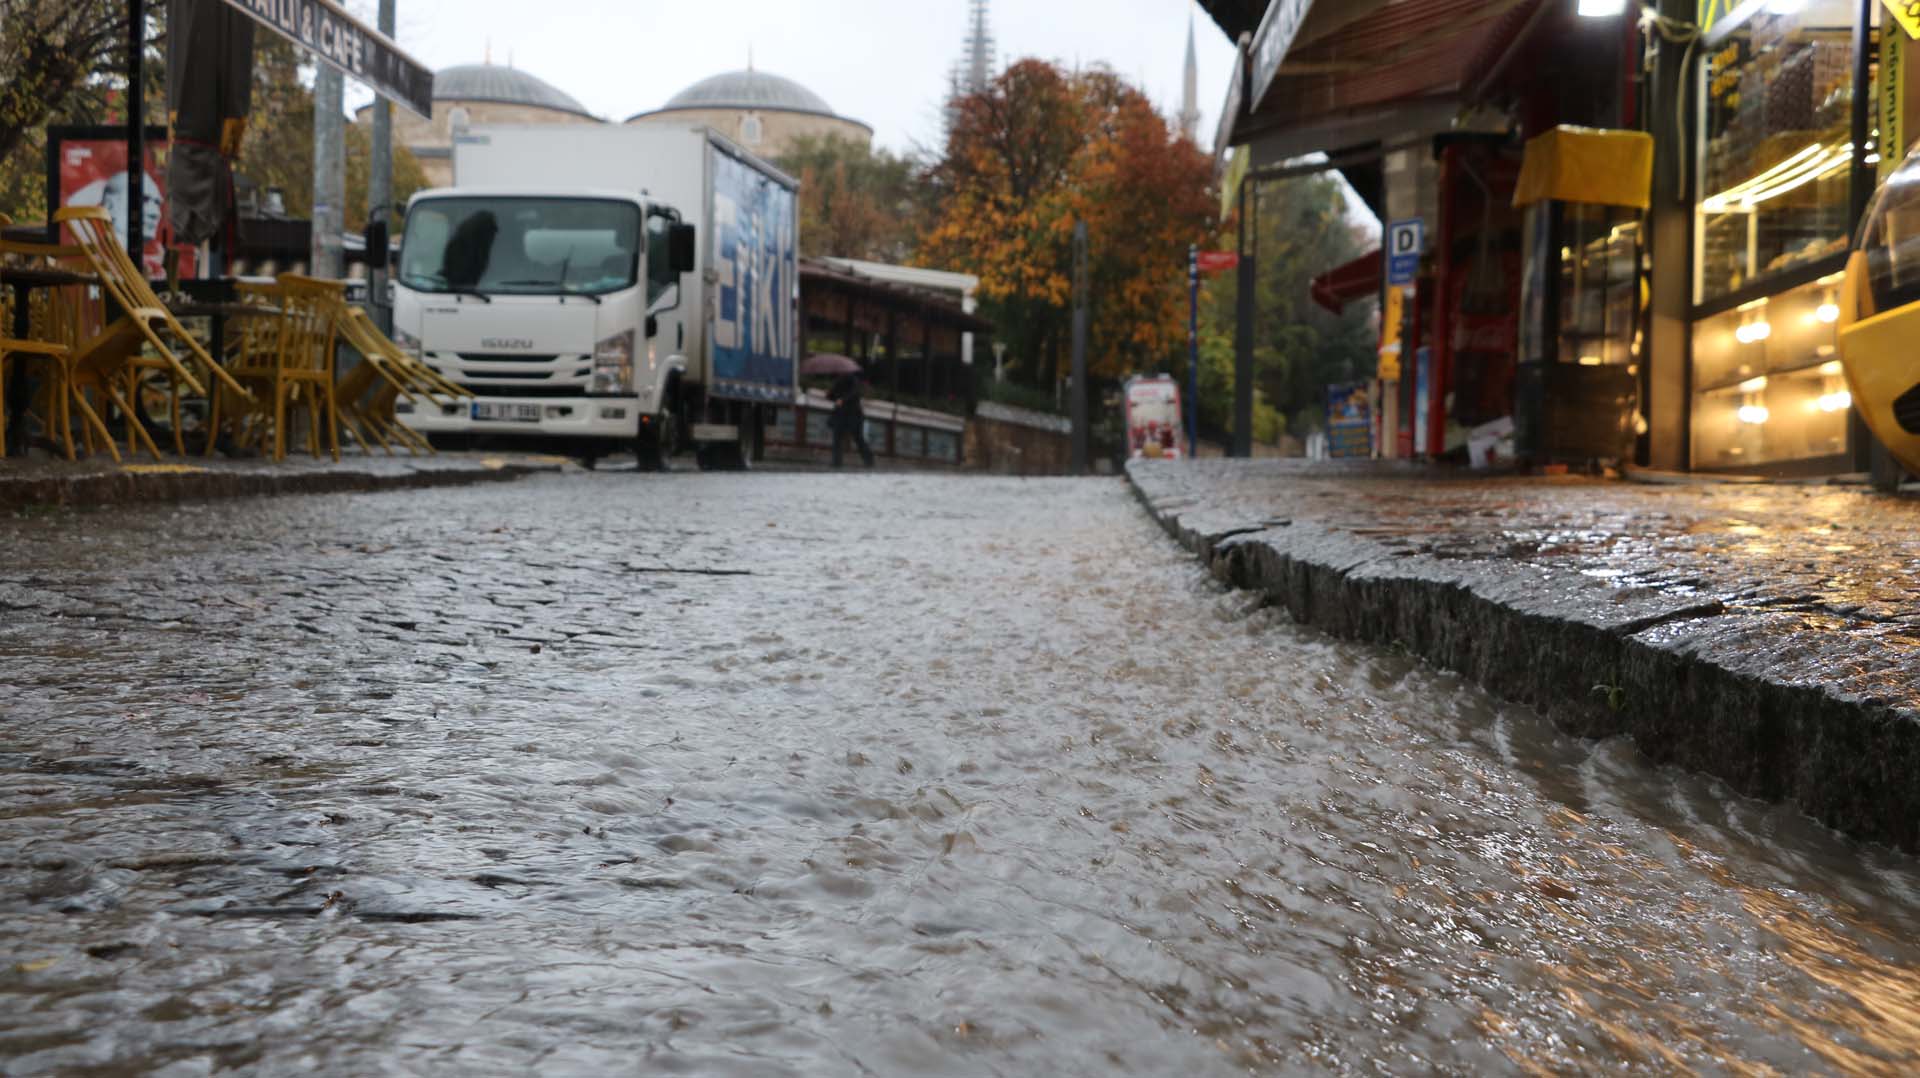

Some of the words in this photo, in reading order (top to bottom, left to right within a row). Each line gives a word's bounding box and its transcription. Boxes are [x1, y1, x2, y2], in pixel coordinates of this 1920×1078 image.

[301, 4, 314, 44] &
[319, 17, 363, 74] CAFE
[1399, 229, 1414, 251] D
[481, 337, 534, 349] ISUZU
